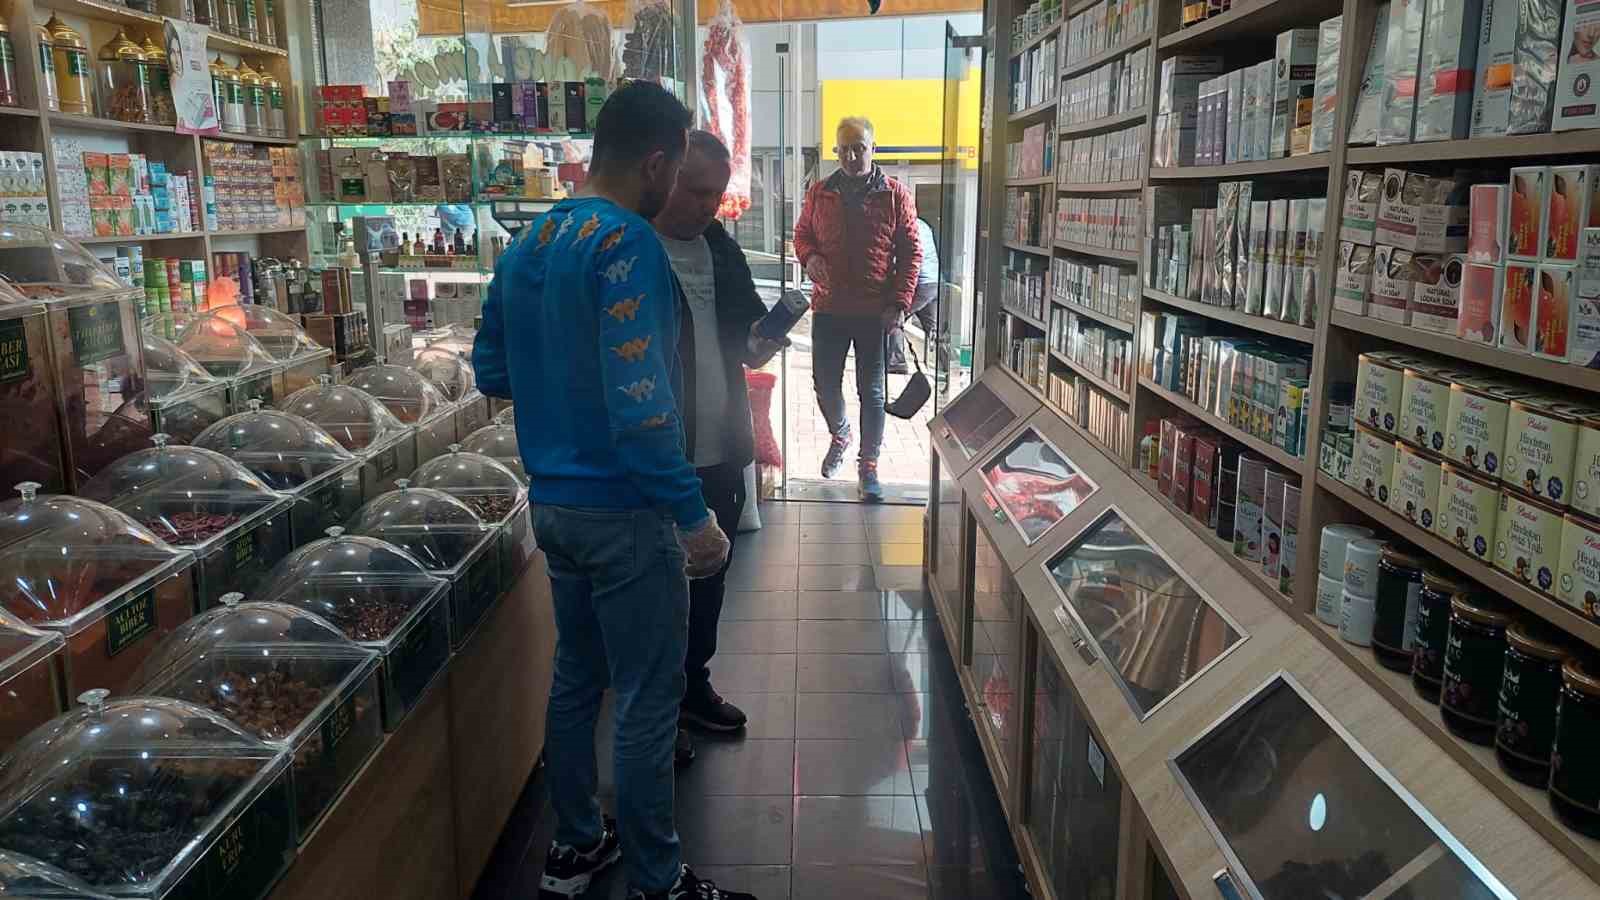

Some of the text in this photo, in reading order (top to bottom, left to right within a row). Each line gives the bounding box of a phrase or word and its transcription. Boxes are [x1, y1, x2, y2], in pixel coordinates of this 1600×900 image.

[1401, 215, 1415, 223] SOAP
[1426, 287, 1450, 296] NATURAL
[1443, 296, 1456, 305] SOAP
[1520, 432, 1551, 449] Hindistan
[1511, 519, 1541, 539] Hindistan
